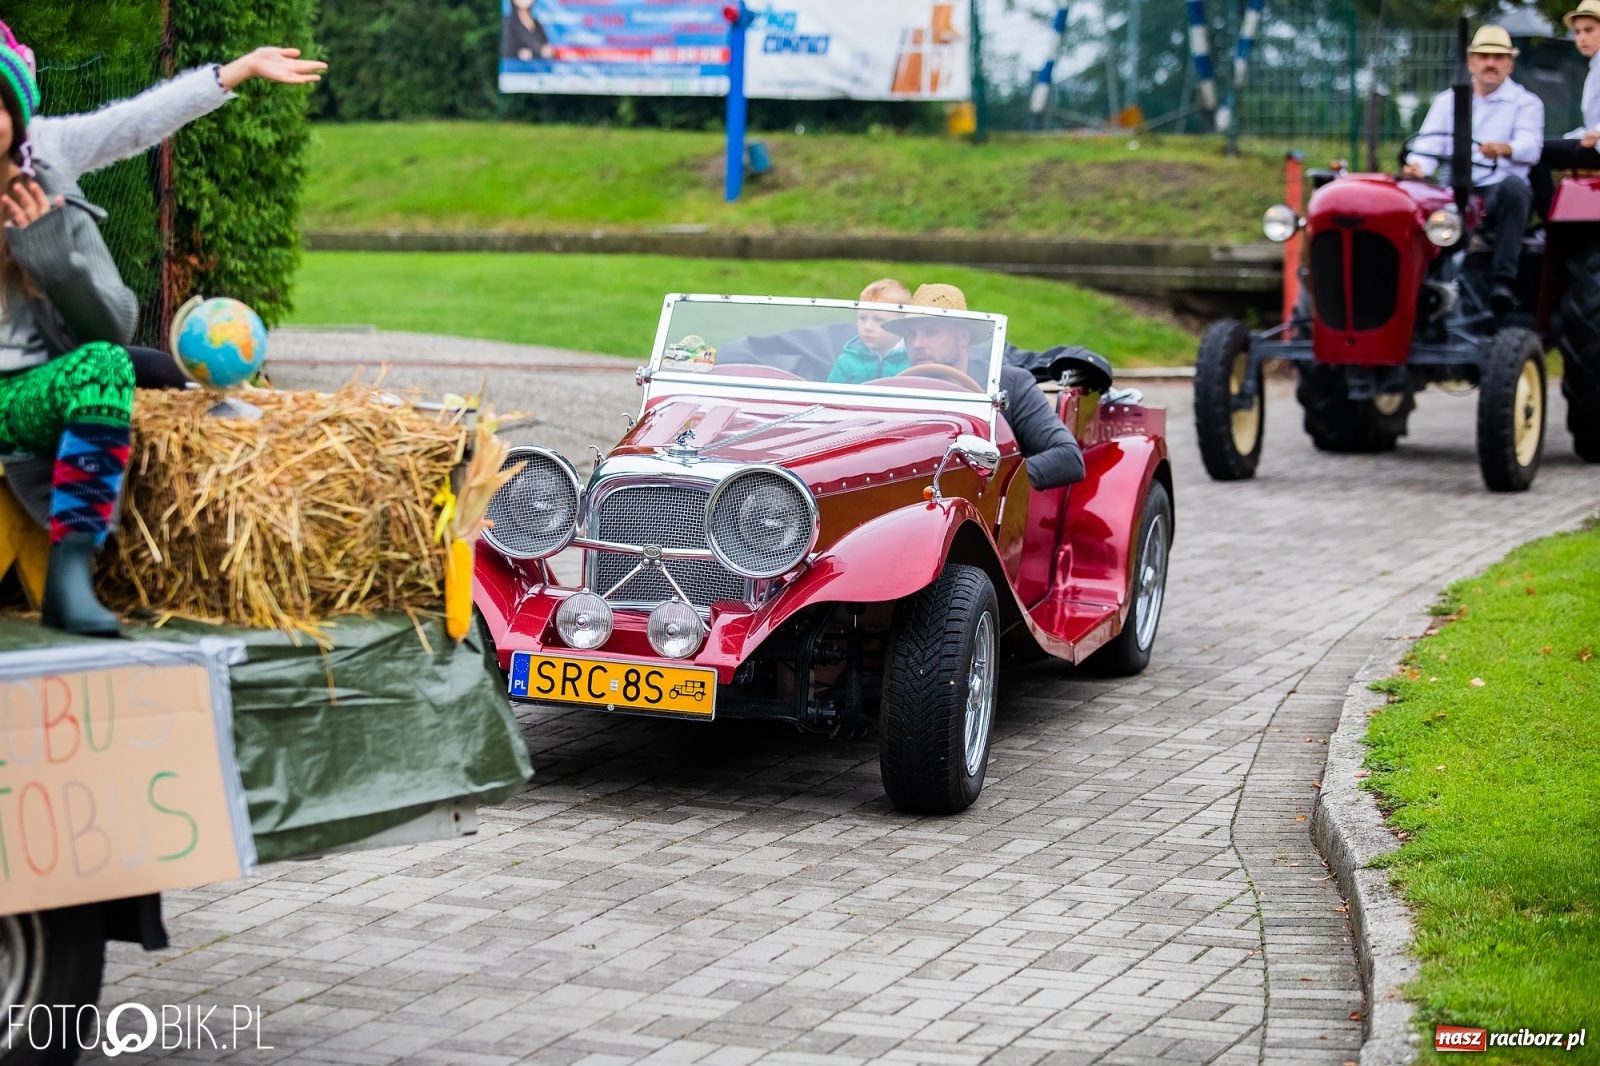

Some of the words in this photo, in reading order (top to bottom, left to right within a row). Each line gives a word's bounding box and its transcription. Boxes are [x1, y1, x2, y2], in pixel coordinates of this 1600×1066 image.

[513, 680, 526, 690] PL
[536, 660, 608, 699] SRC
[622, 668, 665, 704] 8S
[0, 666, 172, 764] OBUS
